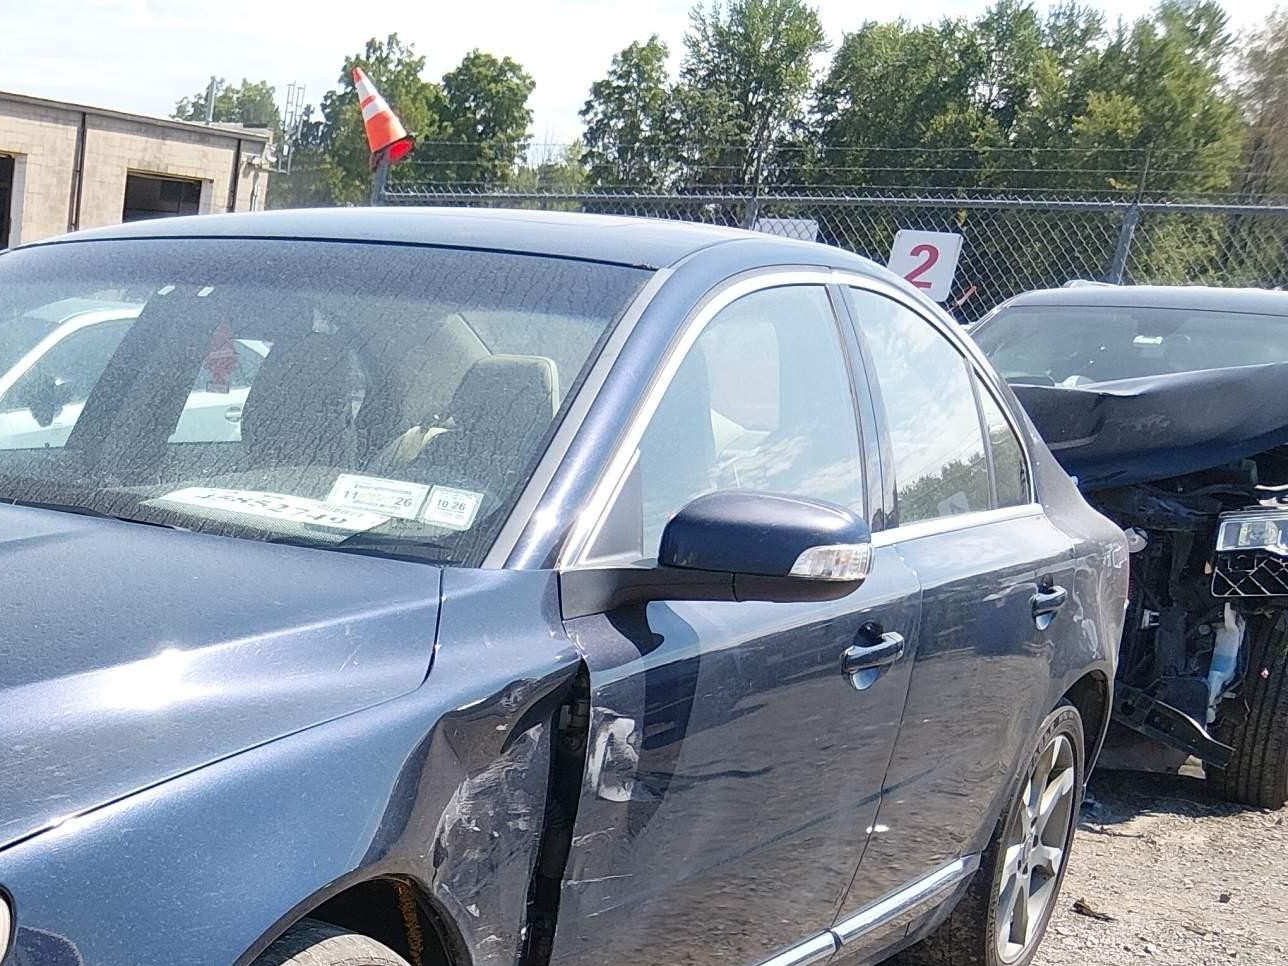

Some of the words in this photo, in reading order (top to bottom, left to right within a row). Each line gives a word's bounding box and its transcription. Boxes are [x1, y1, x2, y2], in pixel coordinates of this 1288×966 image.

[903, 244, 940, 289] 2
[394, 496, 412, 508] 26
[437, 498, 449, 509] 10
[451, 501, 467, 512] 26
